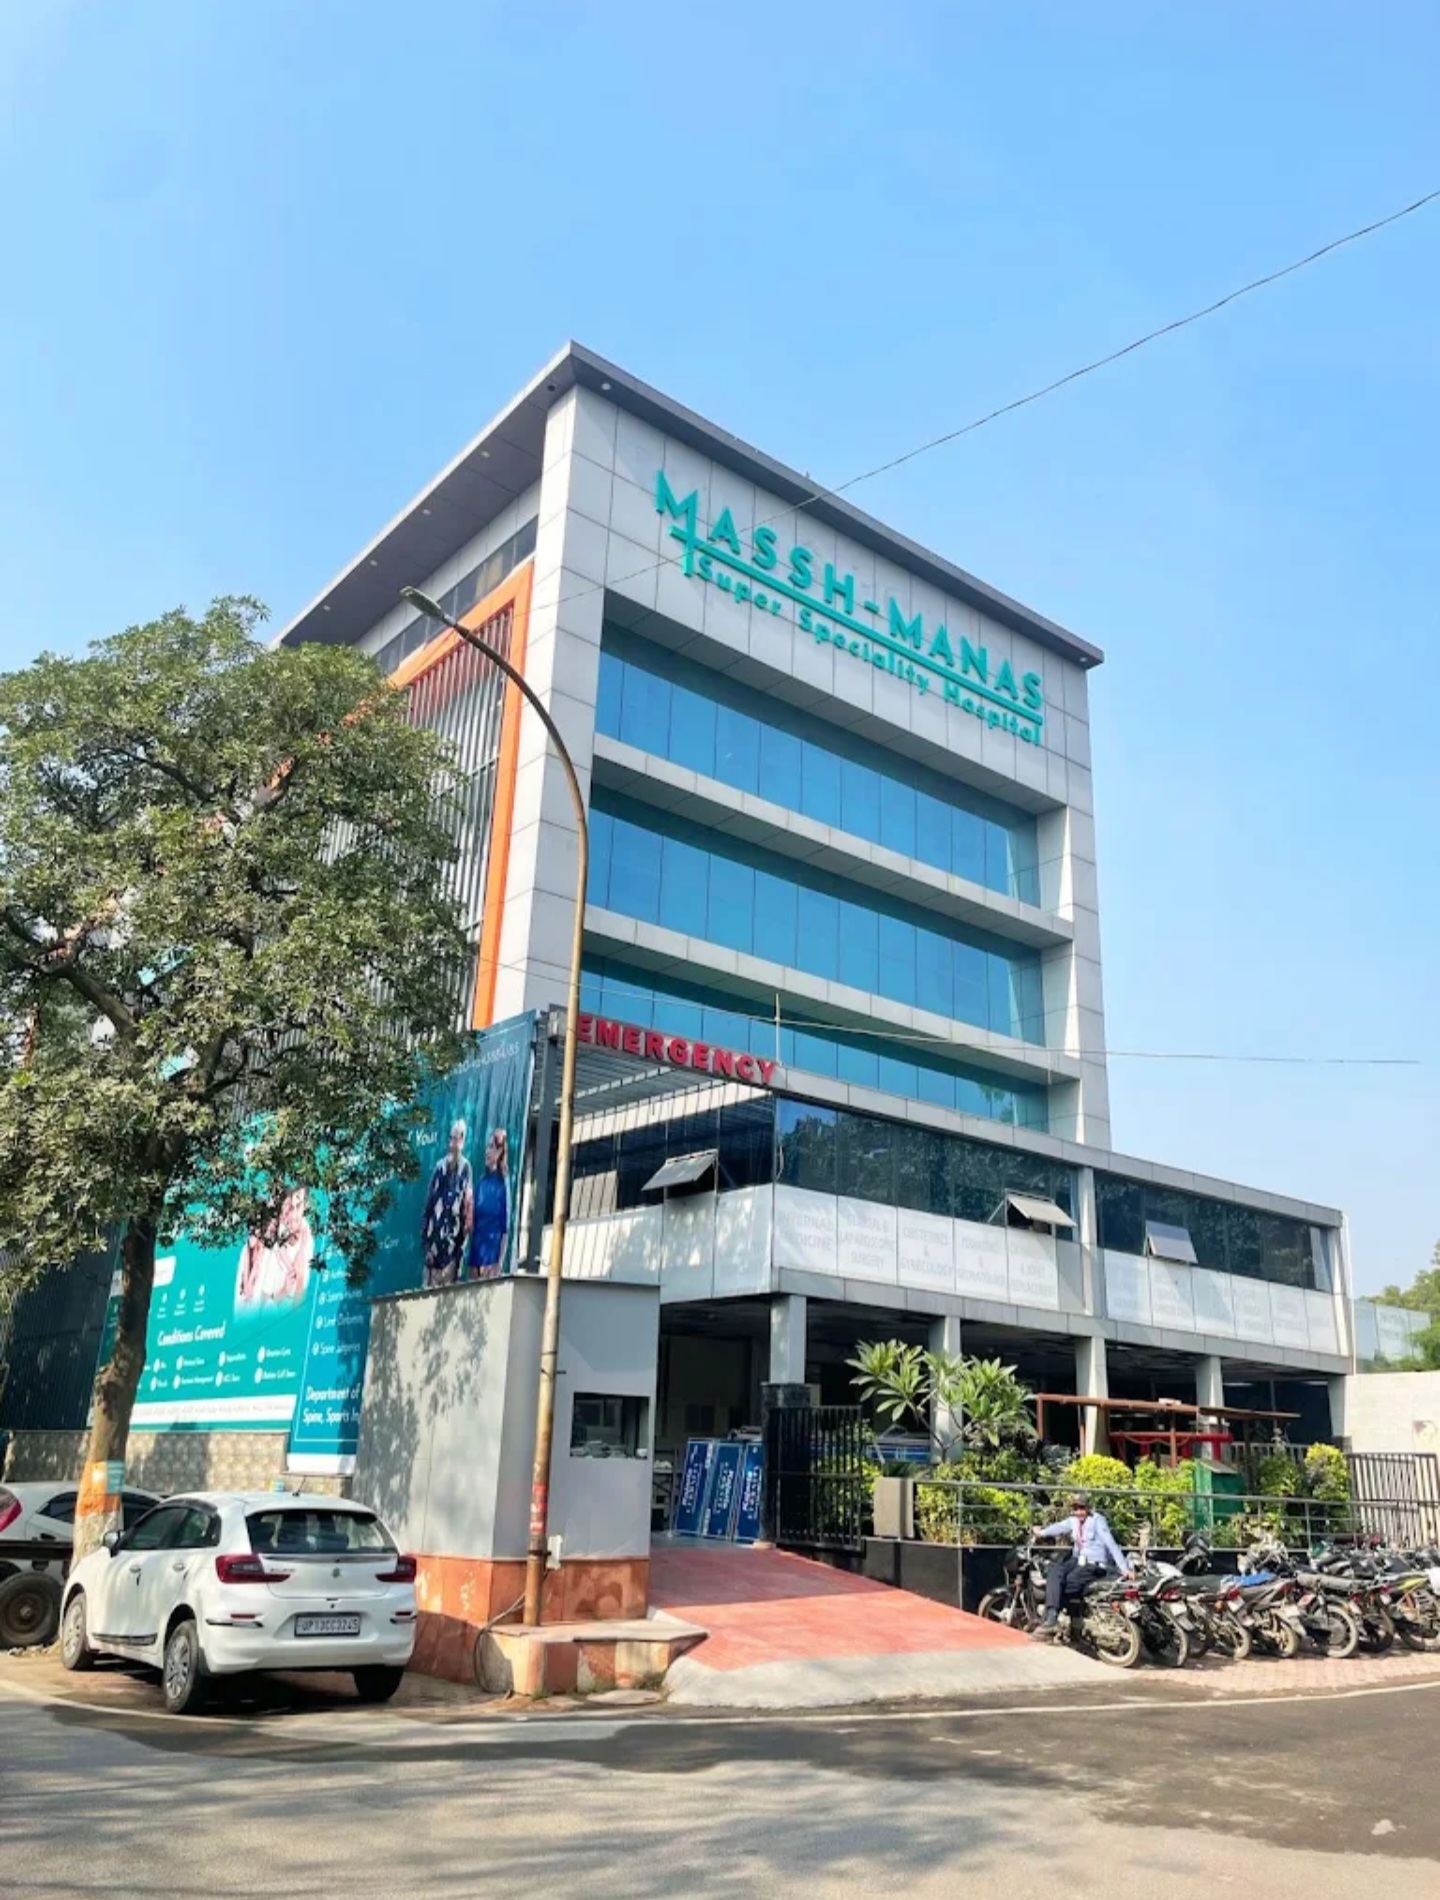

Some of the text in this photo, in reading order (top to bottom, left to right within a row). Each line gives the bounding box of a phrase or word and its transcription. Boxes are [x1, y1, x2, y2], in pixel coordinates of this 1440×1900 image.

[697, 554, 1042, 747] Super Speciality Hospital
[577, 1013, 777, 1084] EMERGENCY
[306, 1382, 361, 1405] Department of
[326, 1406, 349, 1427] Sports
